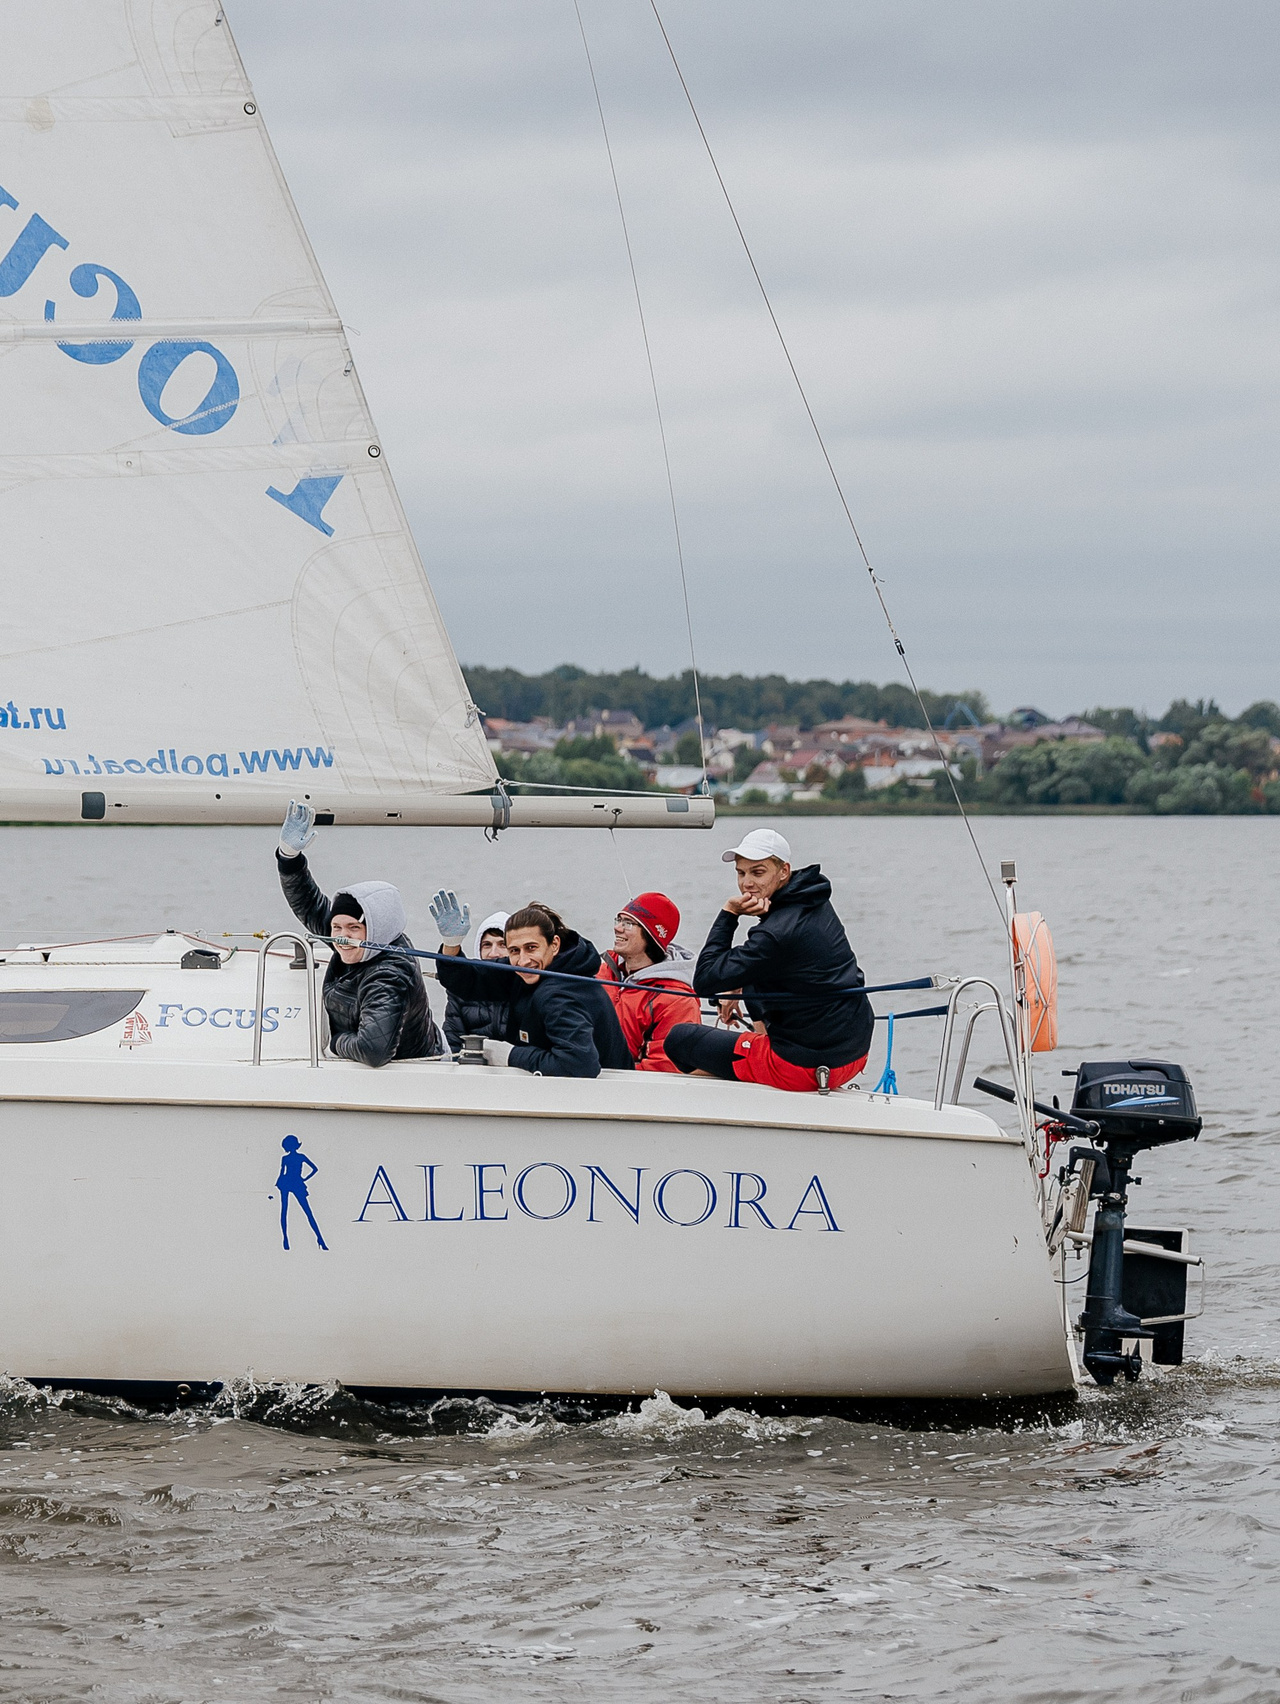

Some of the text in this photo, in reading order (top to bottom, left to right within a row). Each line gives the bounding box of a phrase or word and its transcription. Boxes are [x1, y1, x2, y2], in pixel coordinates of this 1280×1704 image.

[284, 1007, 301, 1019] 27
[1103, 1083, 1166, 1096] TOHATSU
[352, 1162, 845, 1233] ALEONORA
